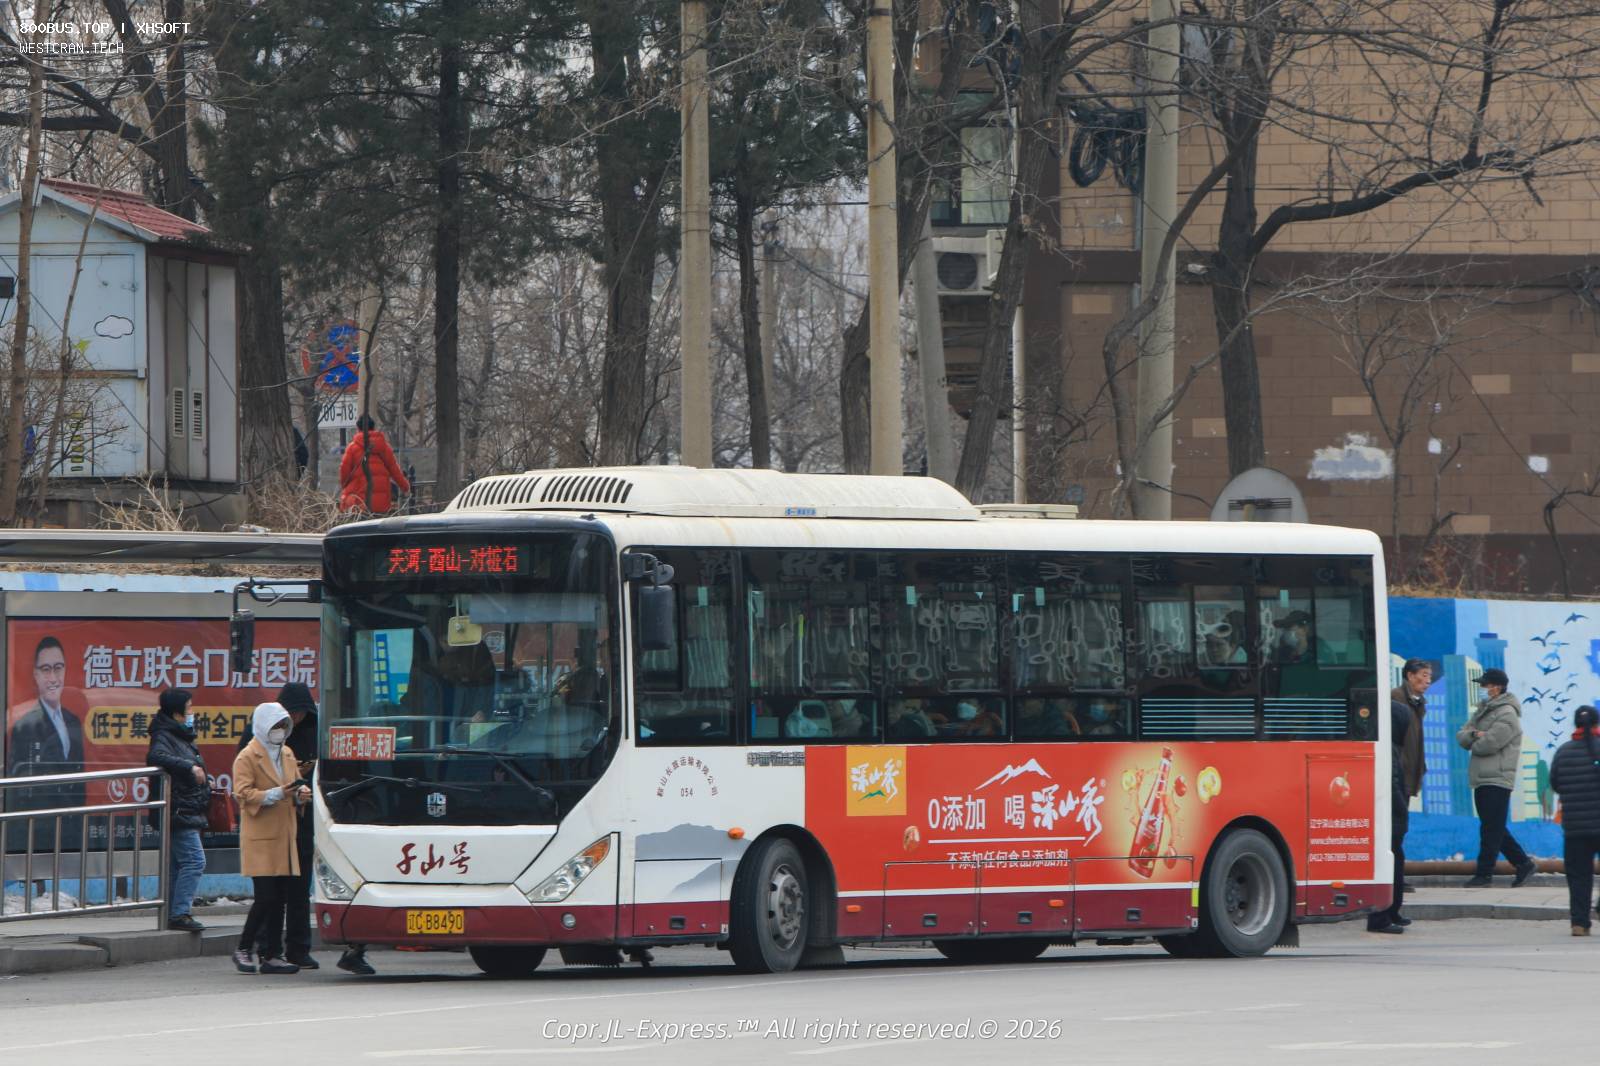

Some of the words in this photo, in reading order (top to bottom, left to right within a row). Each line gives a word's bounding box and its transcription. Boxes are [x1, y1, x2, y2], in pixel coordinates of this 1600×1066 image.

[928, 795, 986, 831] 0添加
[946, 849, 1070, 870] 不添加任何食品添加剂
